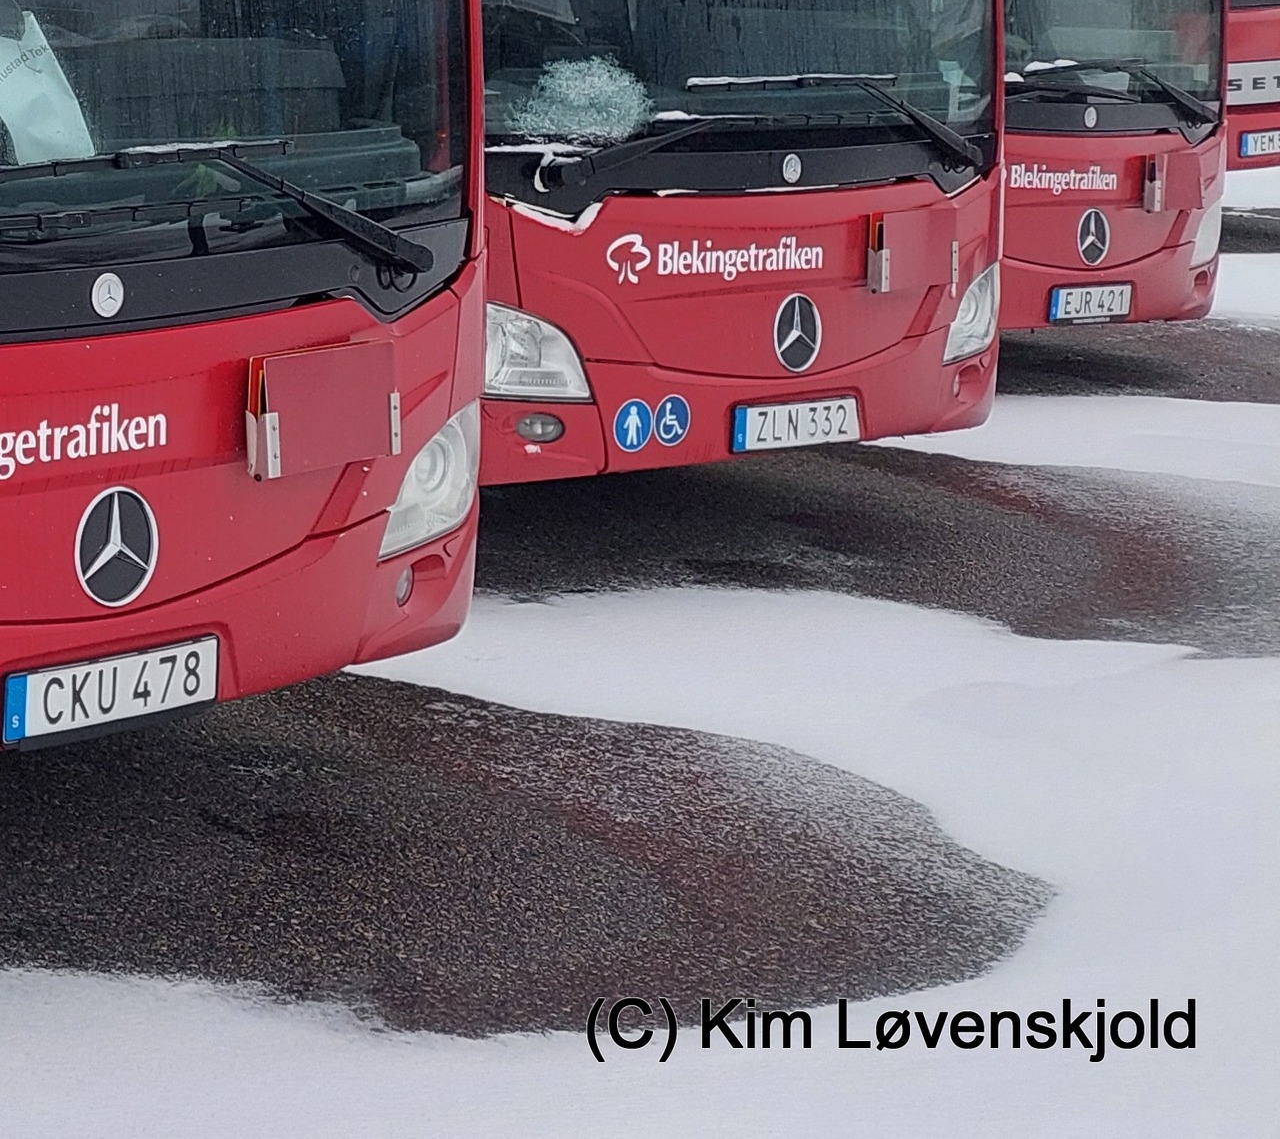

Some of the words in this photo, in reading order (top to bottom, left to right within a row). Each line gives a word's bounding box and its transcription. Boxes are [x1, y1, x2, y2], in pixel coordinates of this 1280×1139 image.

[1009, 164, 1117, 196] Blekingetrafiken
[657, 236, 823, 281] Blekingetrafiken
[1064, 291, 1093, 315] EJR
[1097, 289, 1124, 312] 421
[756, 408, 799, 442] ZLN
[807, 404, 848, 437] 332
[43, 666, 119, 725] CKU
[132, 650, 201, 707] 478
[11, 715, 20, 728] S
